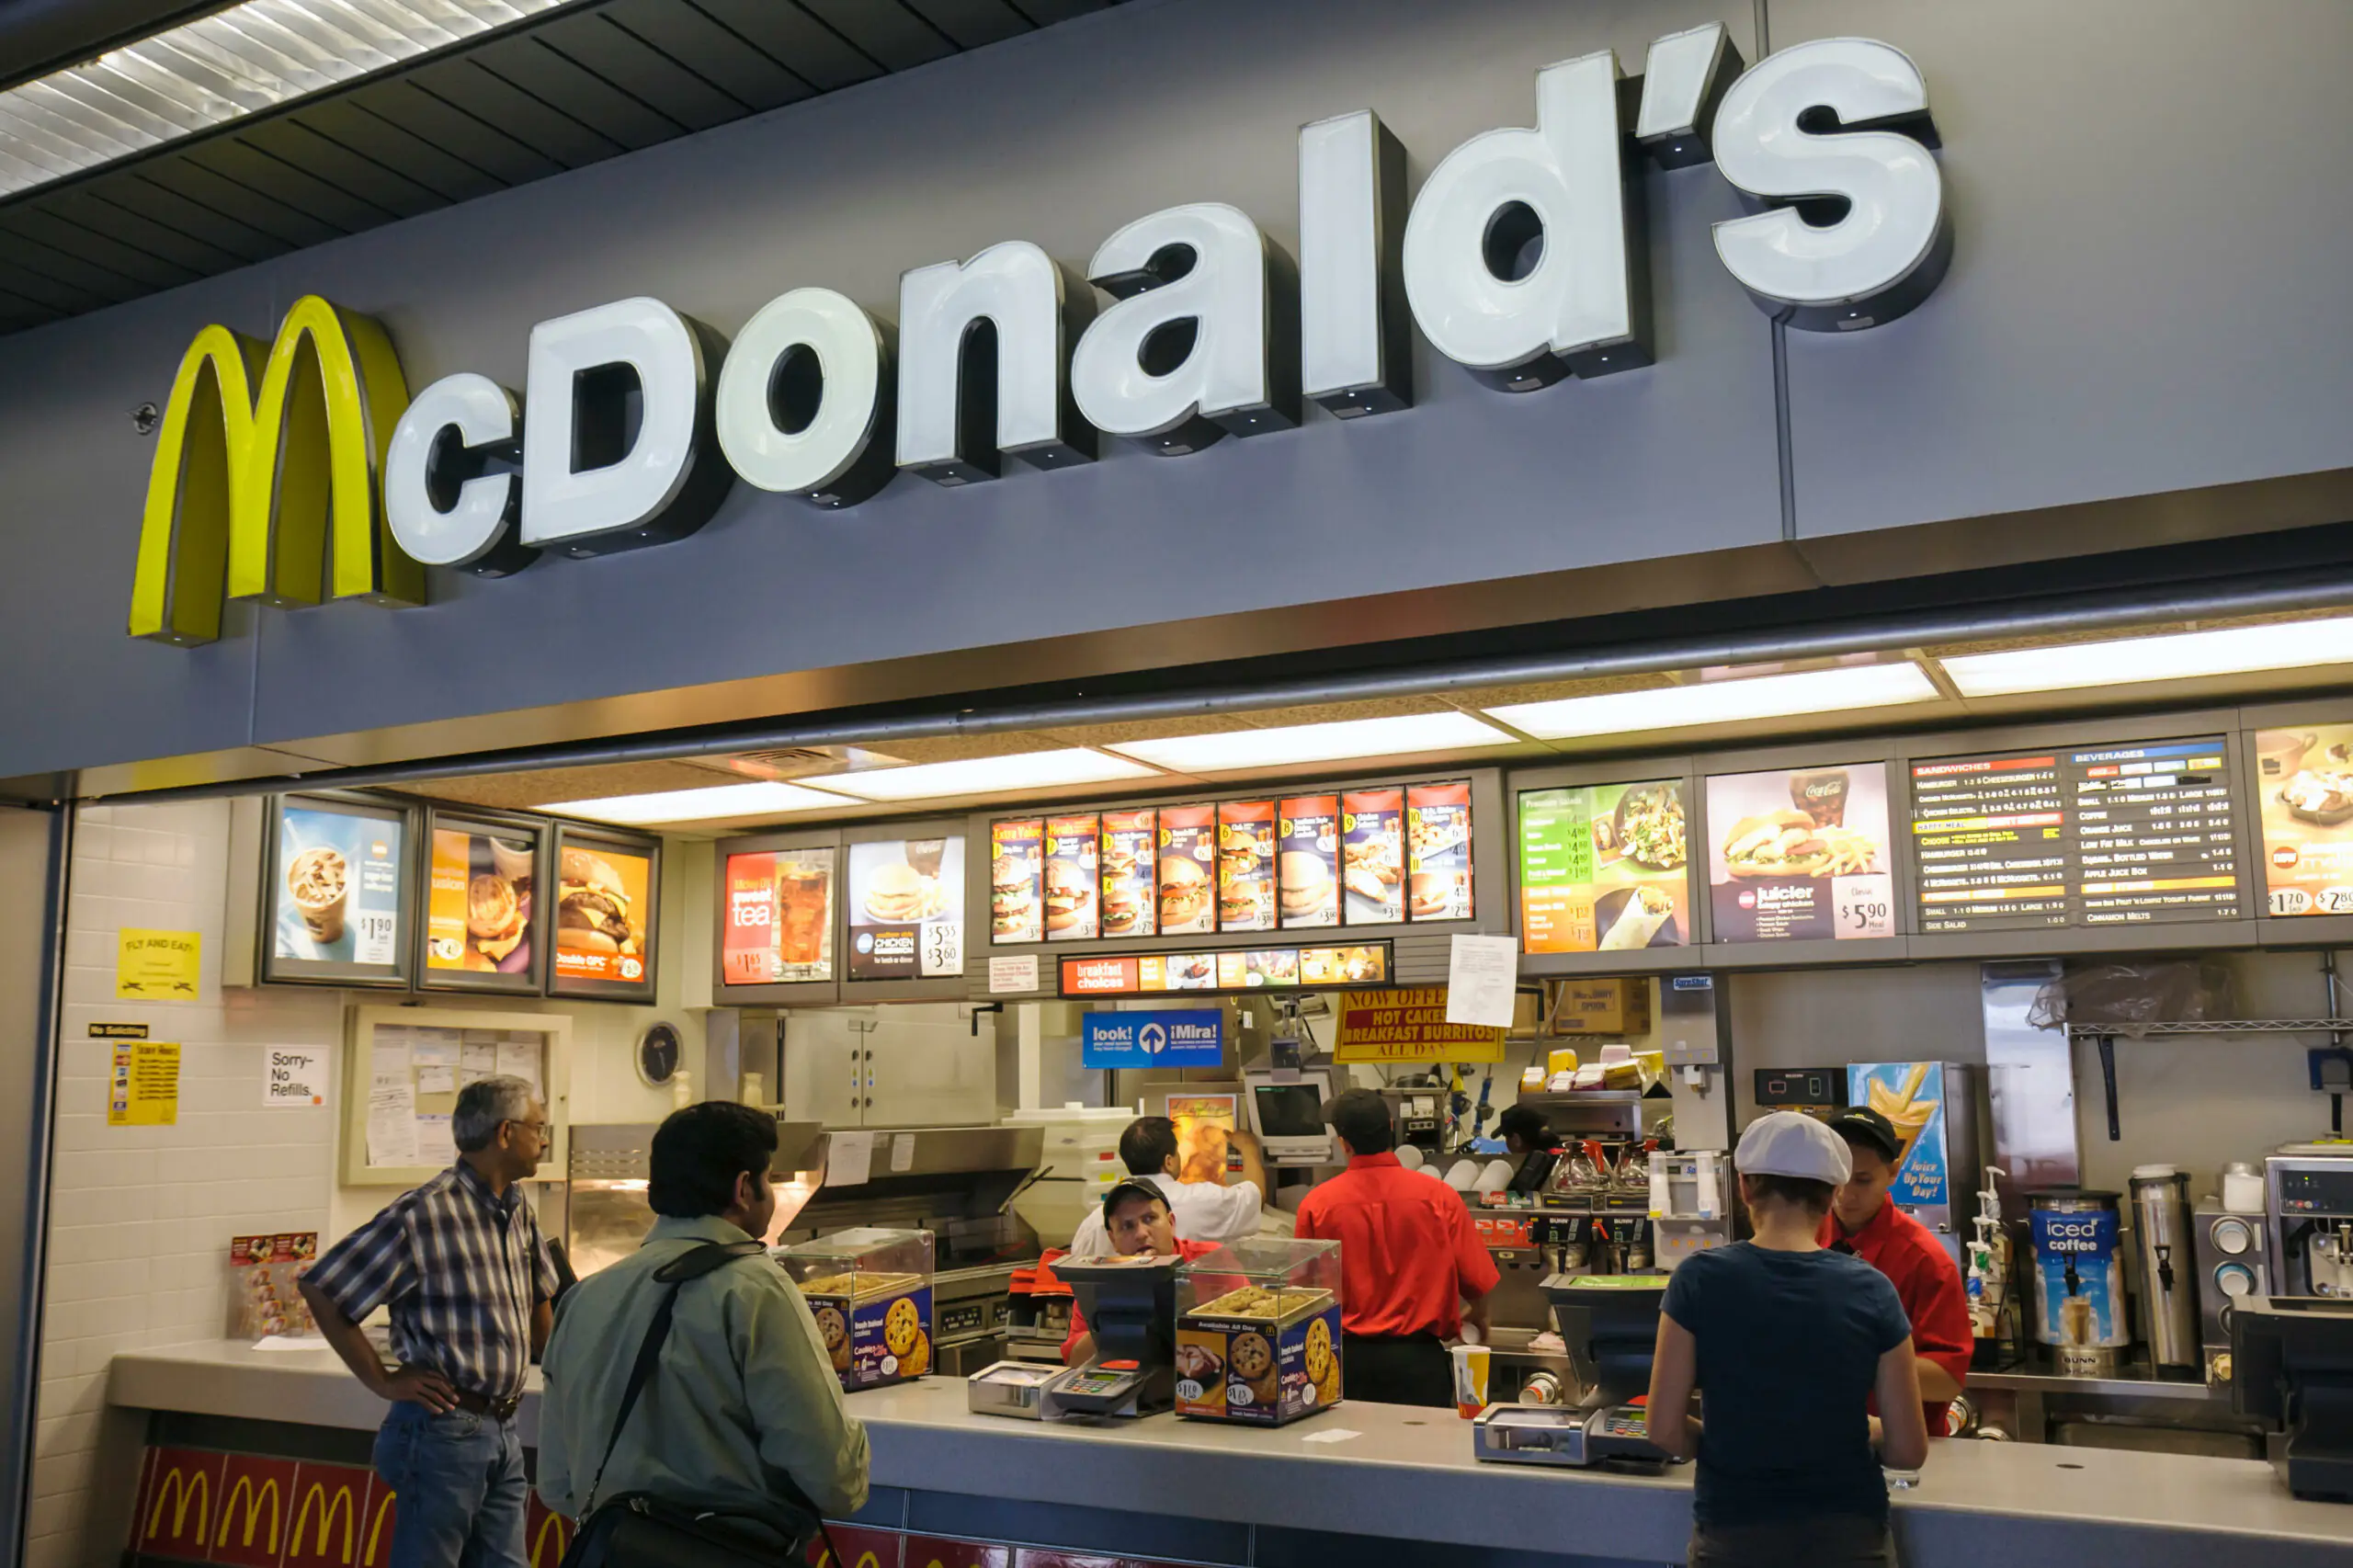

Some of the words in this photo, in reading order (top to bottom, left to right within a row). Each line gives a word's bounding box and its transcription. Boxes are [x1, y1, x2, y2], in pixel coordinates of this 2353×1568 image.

[127, 20, 1950, 645] McDonald's
[2075, 749, 2145, 763] BEVERAGES
[1916, 762, 1992, 776] SANDWICHES
[1410, 812, 1419, 823] 10
[1756, 885, 1815, 908] juicier
[732, 903, 770, 926] tea
[1944, 920, 1966, 929] SALAD
[125, 938, 145, 953] FLY
[146, 937, 168, 949] AND
[874, 937, 915, 949] CHICKEN
[1076, 961, 1123, 978] breakfast
[1076, 976, 1124, 990] choices
[1347, 990, 1389, 1009] NOW
[1397, 989, 1448, 1006] OFFE
[1372, 1010, 1400, 1026] HOT
[1404, 1008, 1447, 1025] CAKES
[90, 1025, 104, 1035] No
[1092, 1026, 1132, 1041] look!
[1344, 1026, 1420, 1043] BREAKFAST
[1423, 1025, 1495, 1041] BURRITOS
[1376, 1044, 1410, 1057] ALL
[1415, 1043, 1449, 1056] DAY
[271, 1068, 290, 1082] No
[270, 1083, 313, 1097] Refills.
[1911, 1161, 1938, 1172] Juice
[1904, 1173, 1917, 1187] Up
[1918, 1173, 1942, 1185] Your
[1912, 1185, 1938, 1199] Day!
[2047, 1219, 2097, 1237] iced
[2048, 1238, 2097, 1251] coffee
[1198, 1321, 1230, 1330] Available
[1242, 1324, 1257, 1333] Day
